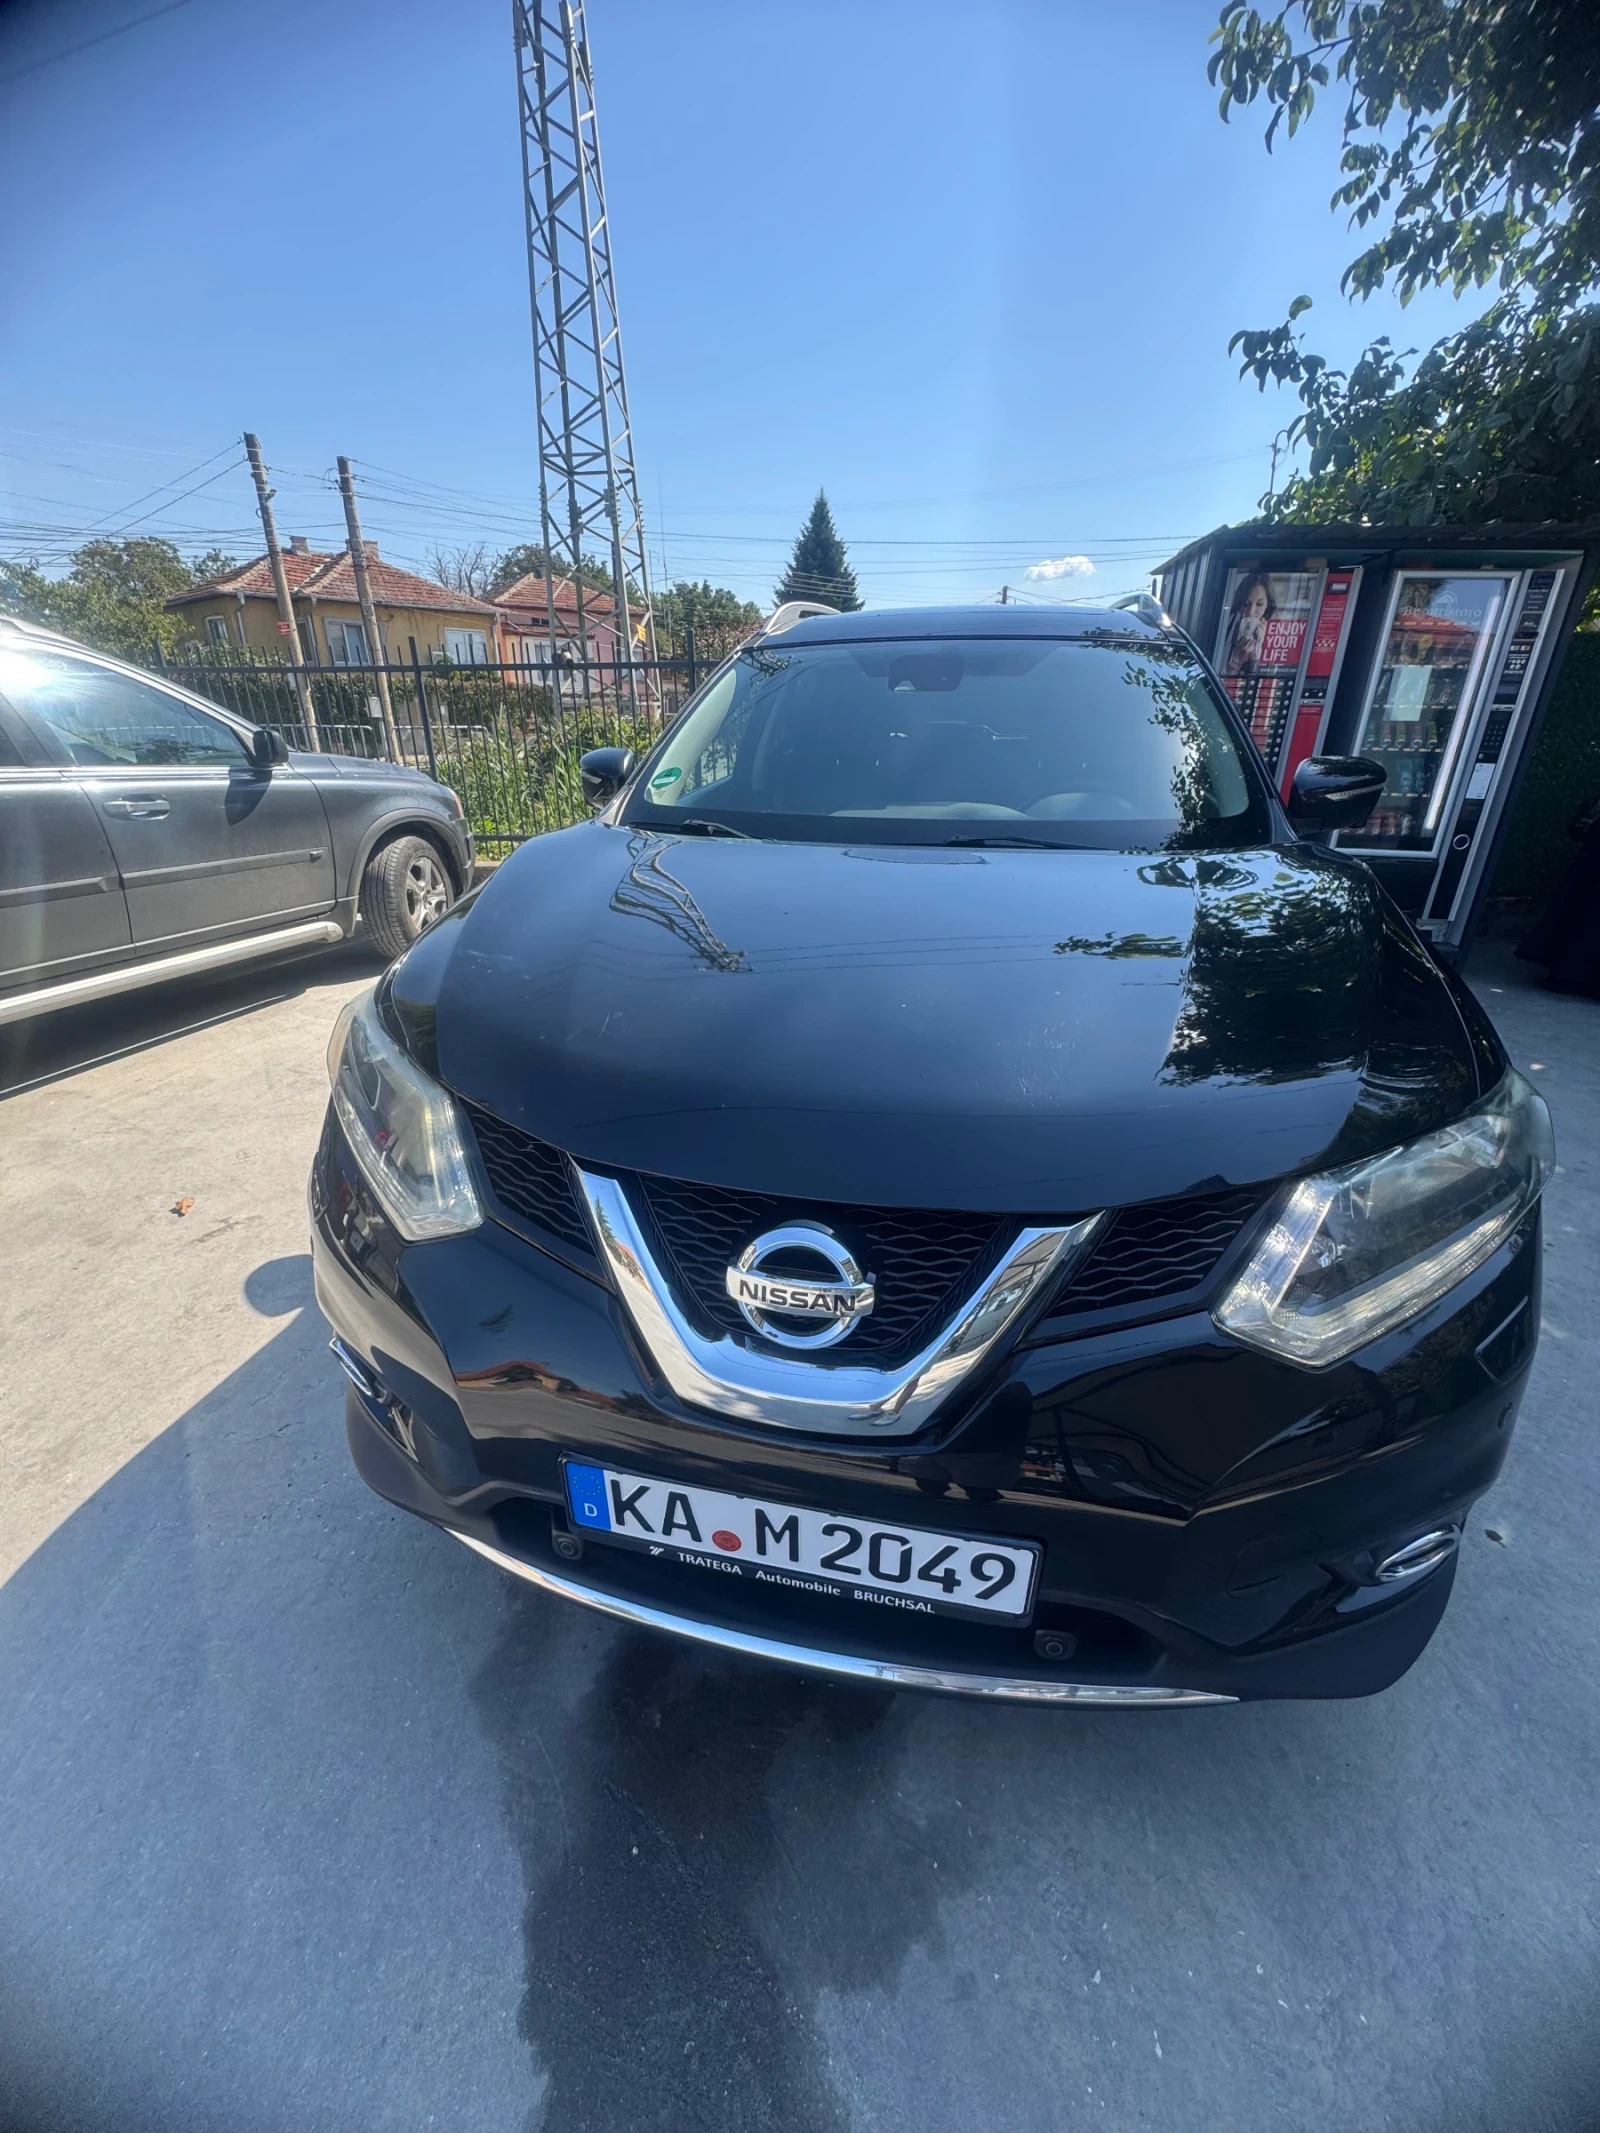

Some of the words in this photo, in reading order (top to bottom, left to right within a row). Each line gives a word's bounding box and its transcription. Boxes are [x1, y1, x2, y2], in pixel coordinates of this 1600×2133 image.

[1267, 622, 1308, 635] ENJOY
[1266, 635, 1298, 648] YOUR
[1262, 649, 1288, 661] LIFE
[739, 1279, 857, 1312] NISSAN
[584, 1503, 598, 1517] D
[610, 1479, 703, 1543] KA
[754, 1507, 799, 1563] M
[820, 1523, 1016, 1600] 2049
[677, 1551, 743, 1576] TRATEGA
[755, 1569, 841, 1596] Automobile
[853, 1590, 935, 1614] BRUCHSAL
